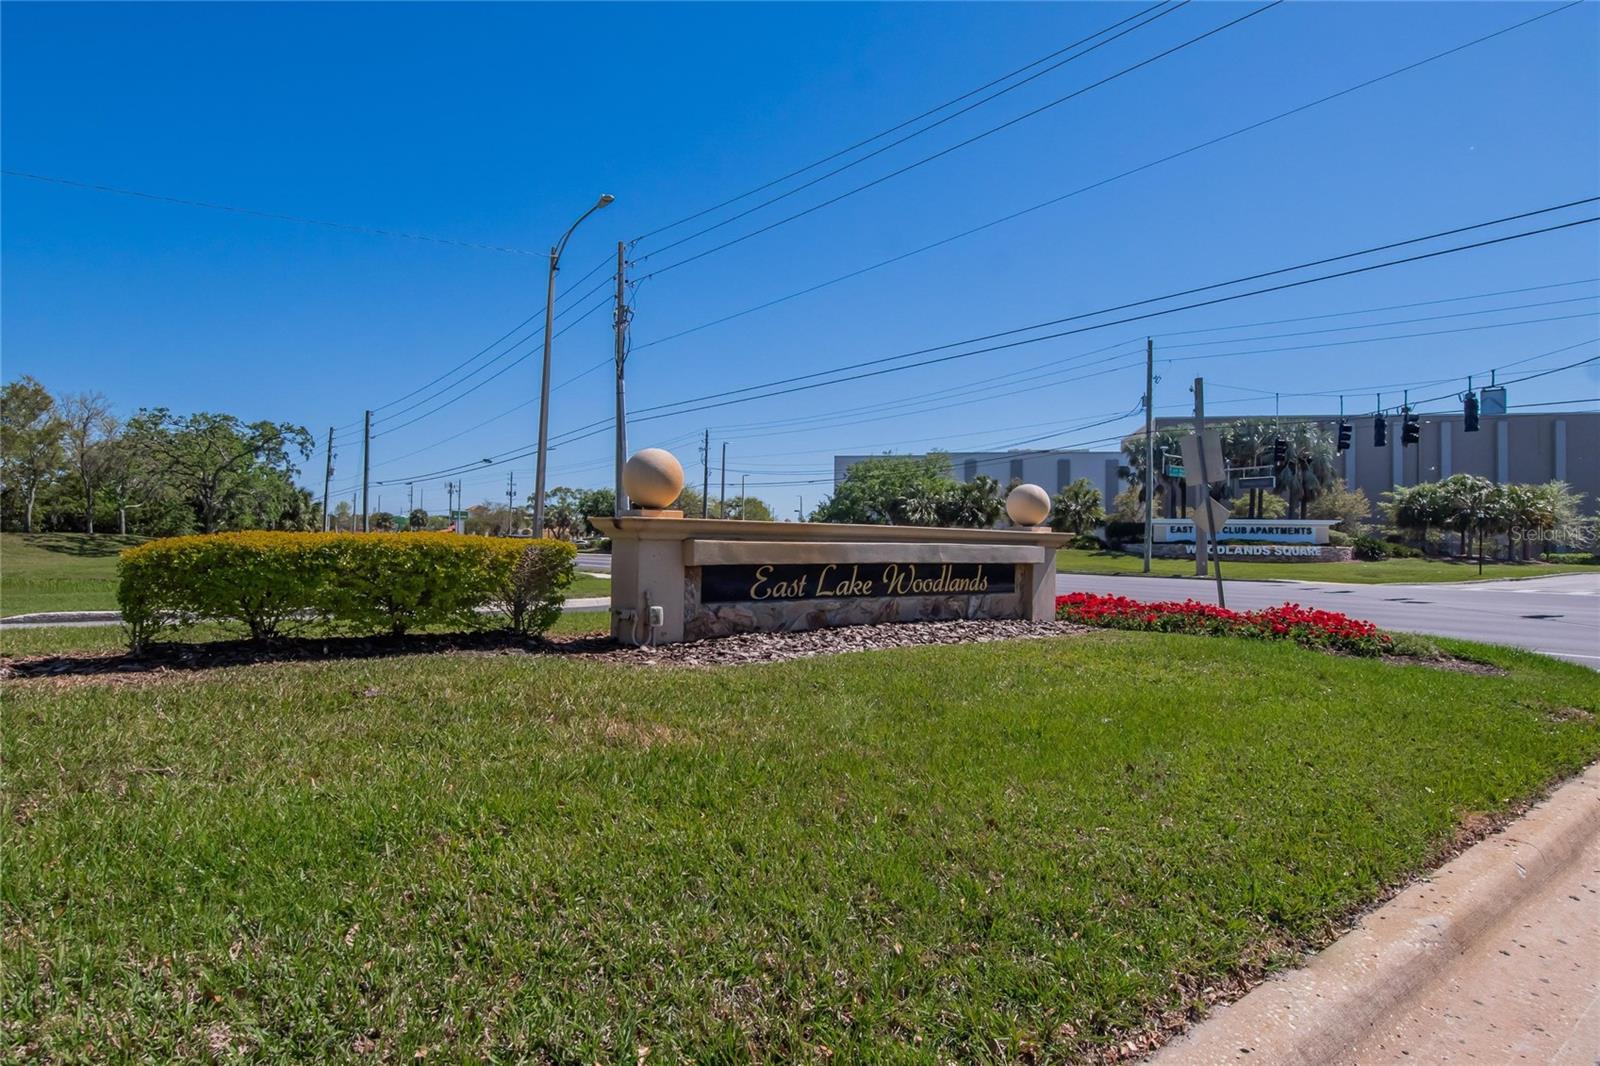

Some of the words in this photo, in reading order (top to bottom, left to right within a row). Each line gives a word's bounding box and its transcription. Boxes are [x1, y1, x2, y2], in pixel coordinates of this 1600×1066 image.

[1170, 526, 1193, 534] EAST
[1222, 526, 1247, 535] CLUB
[1249, 526, 1312, 535] APARTMENTS
[1185, 544, 1270, 556] WODLANDS
[1274, 545, 1322, 557] SQUARE
[750, 565, 807, 600] East
[815, 564, 872, 597] Lake
[882, 564, 988, 595] Woodlands
